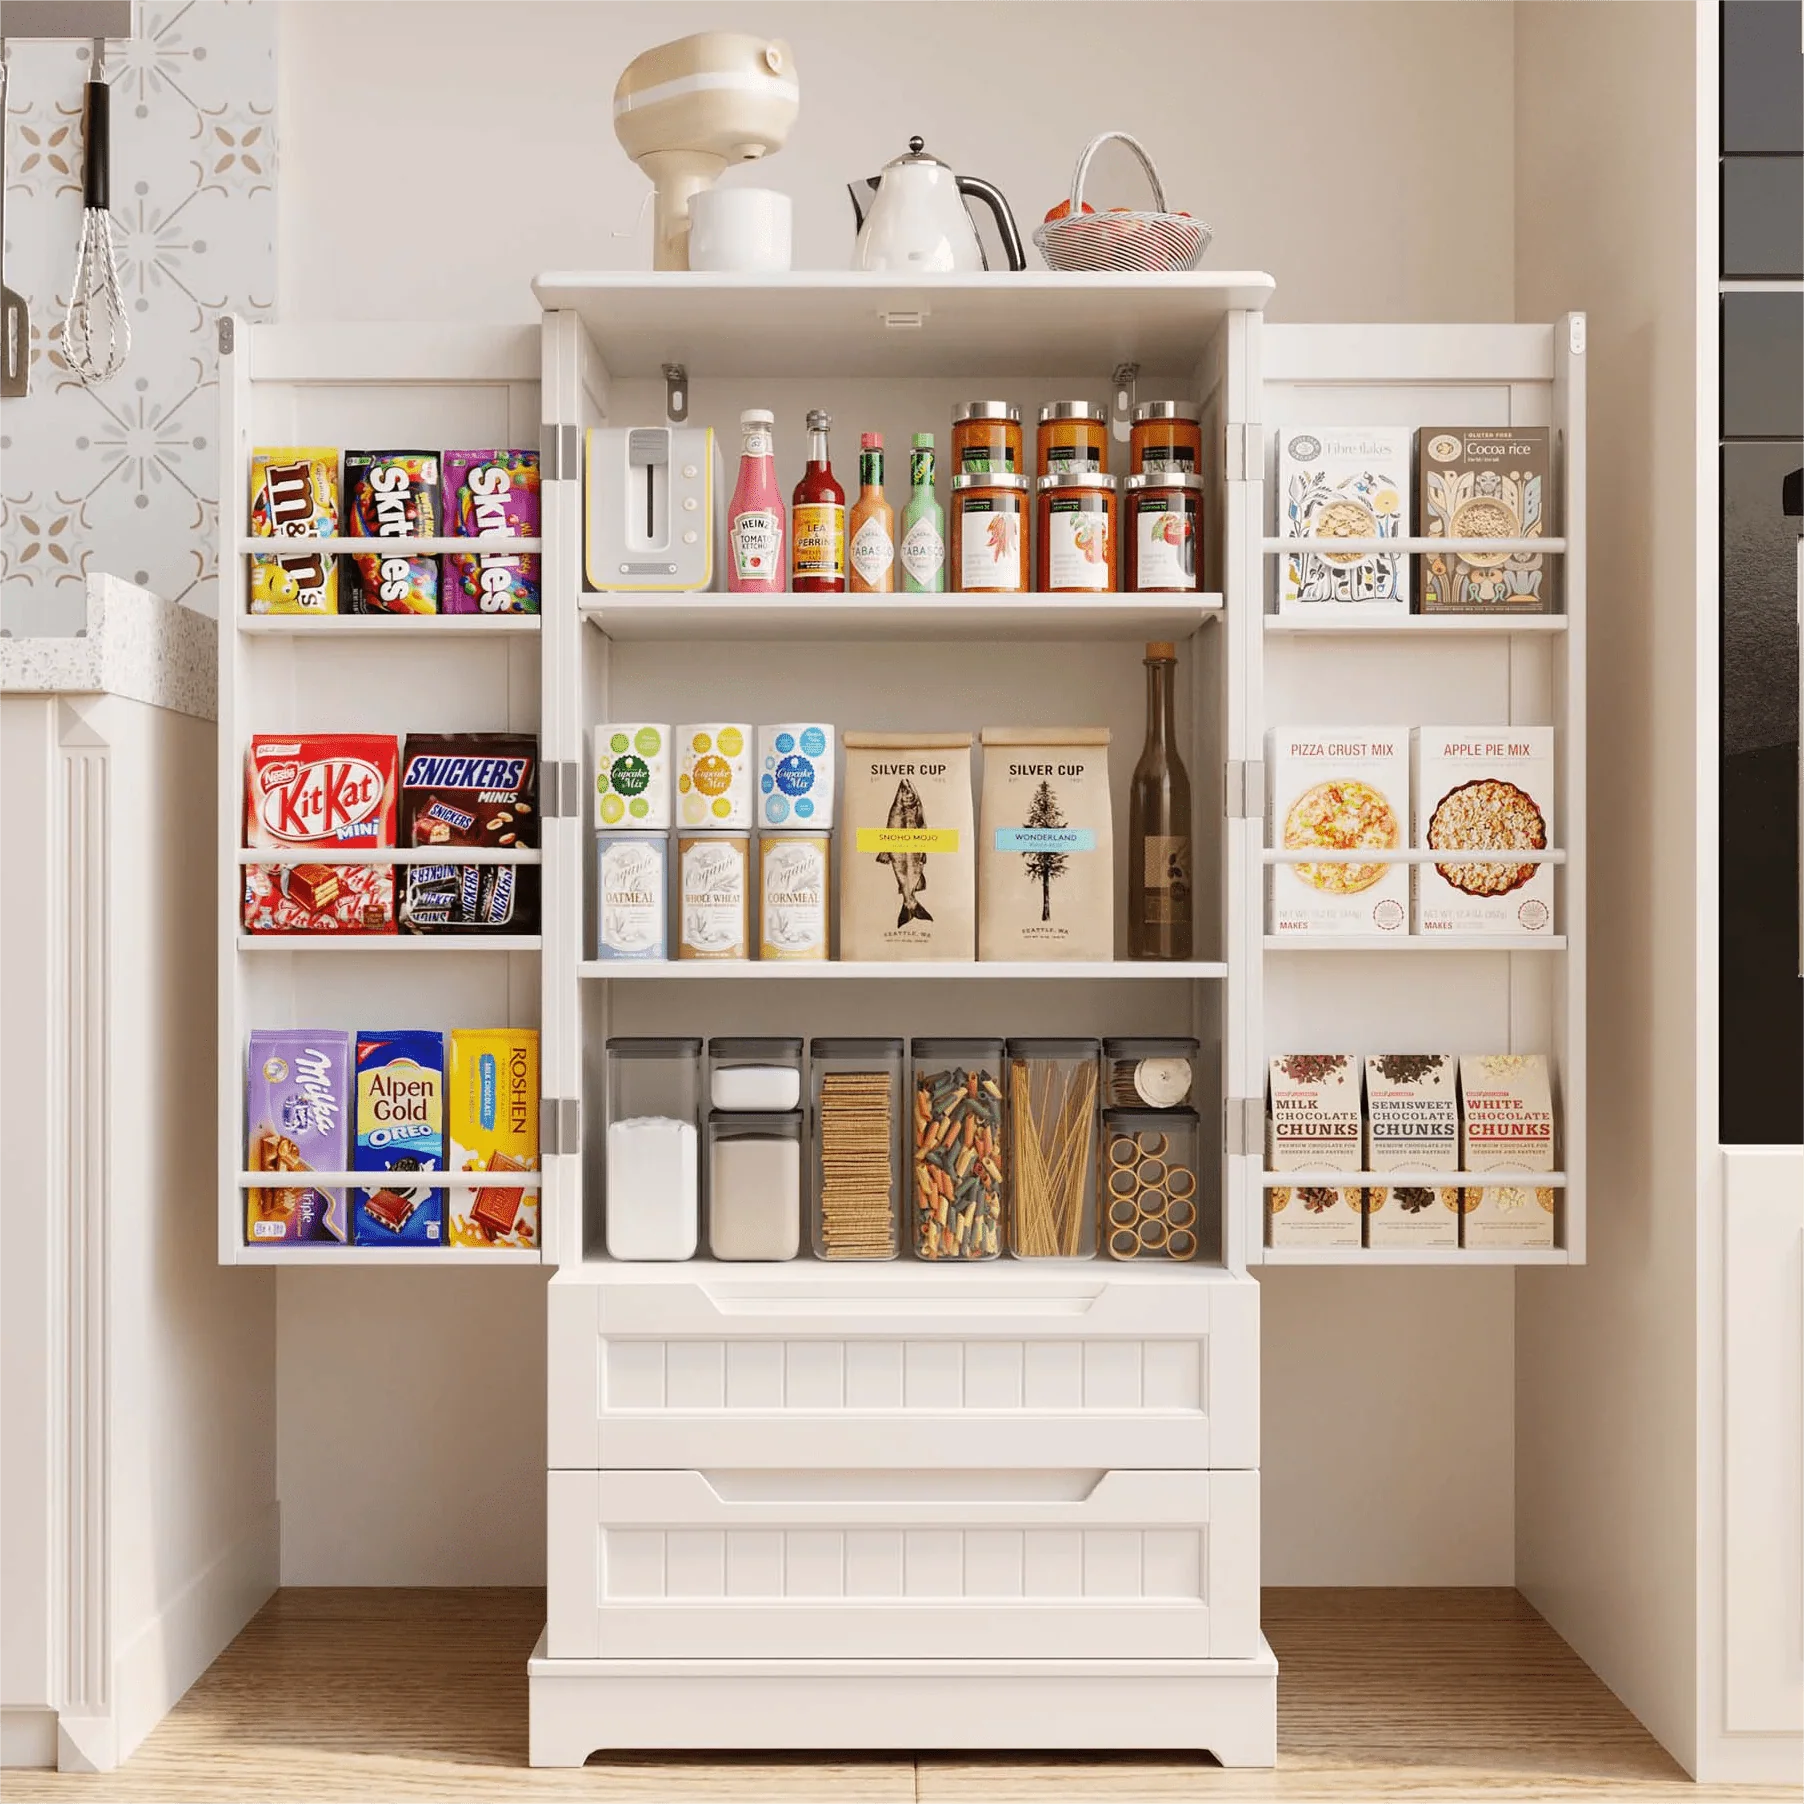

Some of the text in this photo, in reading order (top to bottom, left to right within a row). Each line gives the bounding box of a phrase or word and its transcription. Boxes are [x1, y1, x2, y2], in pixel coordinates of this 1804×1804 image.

[1467, 442, 1531, 455] Cocoa rice
[1291, 744, 1394, 756] PIZZA CRUST MIX
[1444, 744, 1530, 756] APPLE PIE MIX
[405, 757, 524, 789] SNICKERS
[871, 764, 946, 775] SILVER CUP
[1009, 764, 1084, 776] SILVER CUP
[278, 764, 373, 834] KitKat
[478, 791, 519, 803] MINIS
[430, 804, 472, 830] SNICKERS
[606, 892, 654, 903] OATMEAL
[685, 894, 740, 903] WHOLE WHEAT
[767, 892, 820, 903] CORNMEAL
[1280, 922, 1308, 930] MAKES
[1424, 922, 1452, 930] MAKES
[295, 1048, 339, 1136] Milka
[369, 1073, 434, 1103] Alpen
[510, 1048, 527, 1134] ROSHEN
[374, 1098, 427, 1121] Gold
[1276, 1100, 1318, 1109] MILK
[1372, 1101, 1453, 1109] SEMISWEET
[1467, 1100, 1523, 1109] WHITE
[1276, 1112, 1357, 1120] CHOCOLATE
[1373, 1112, 1454, 1120] CHOCOLATE
[1468, 1112, 1550, 1120] CHOCOLATE
[1276, 1123, 1358, 1135] CHUNKS
[1373, 1123, 1454, 1135] CHUNKS
[1469, 1123, 1550, 1135] CHUNKS
[369, 1125, 432, 1147] OREO
[301, 1191, 315, 1223] Triple
